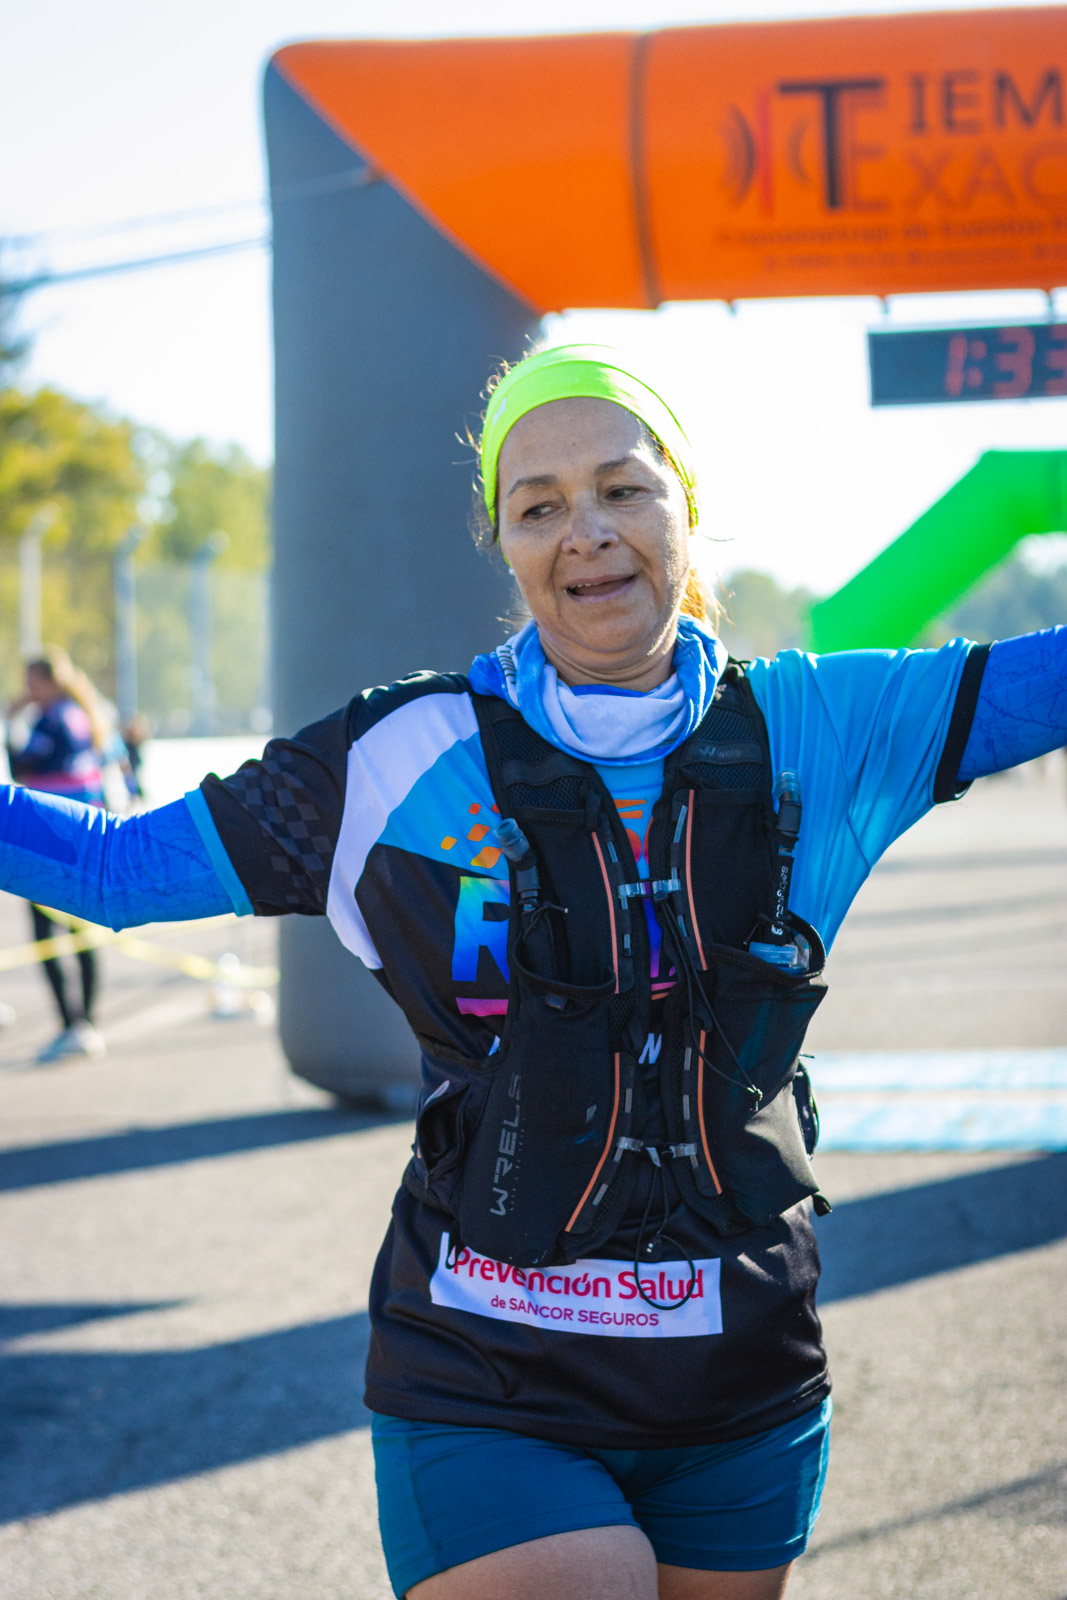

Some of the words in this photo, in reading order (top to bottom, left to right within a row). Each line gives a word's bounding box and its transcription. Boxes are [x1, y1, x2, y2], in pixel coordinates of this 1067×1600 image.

[452, 1247, 611, 1299] Prevención
[618, 1269, 704, 1301] Salud
[490, 1295, 506, 1309] de
[509, 1298, 574, 1321] SANCOR
[577, 1309, 660, 1326] SEGUROS
